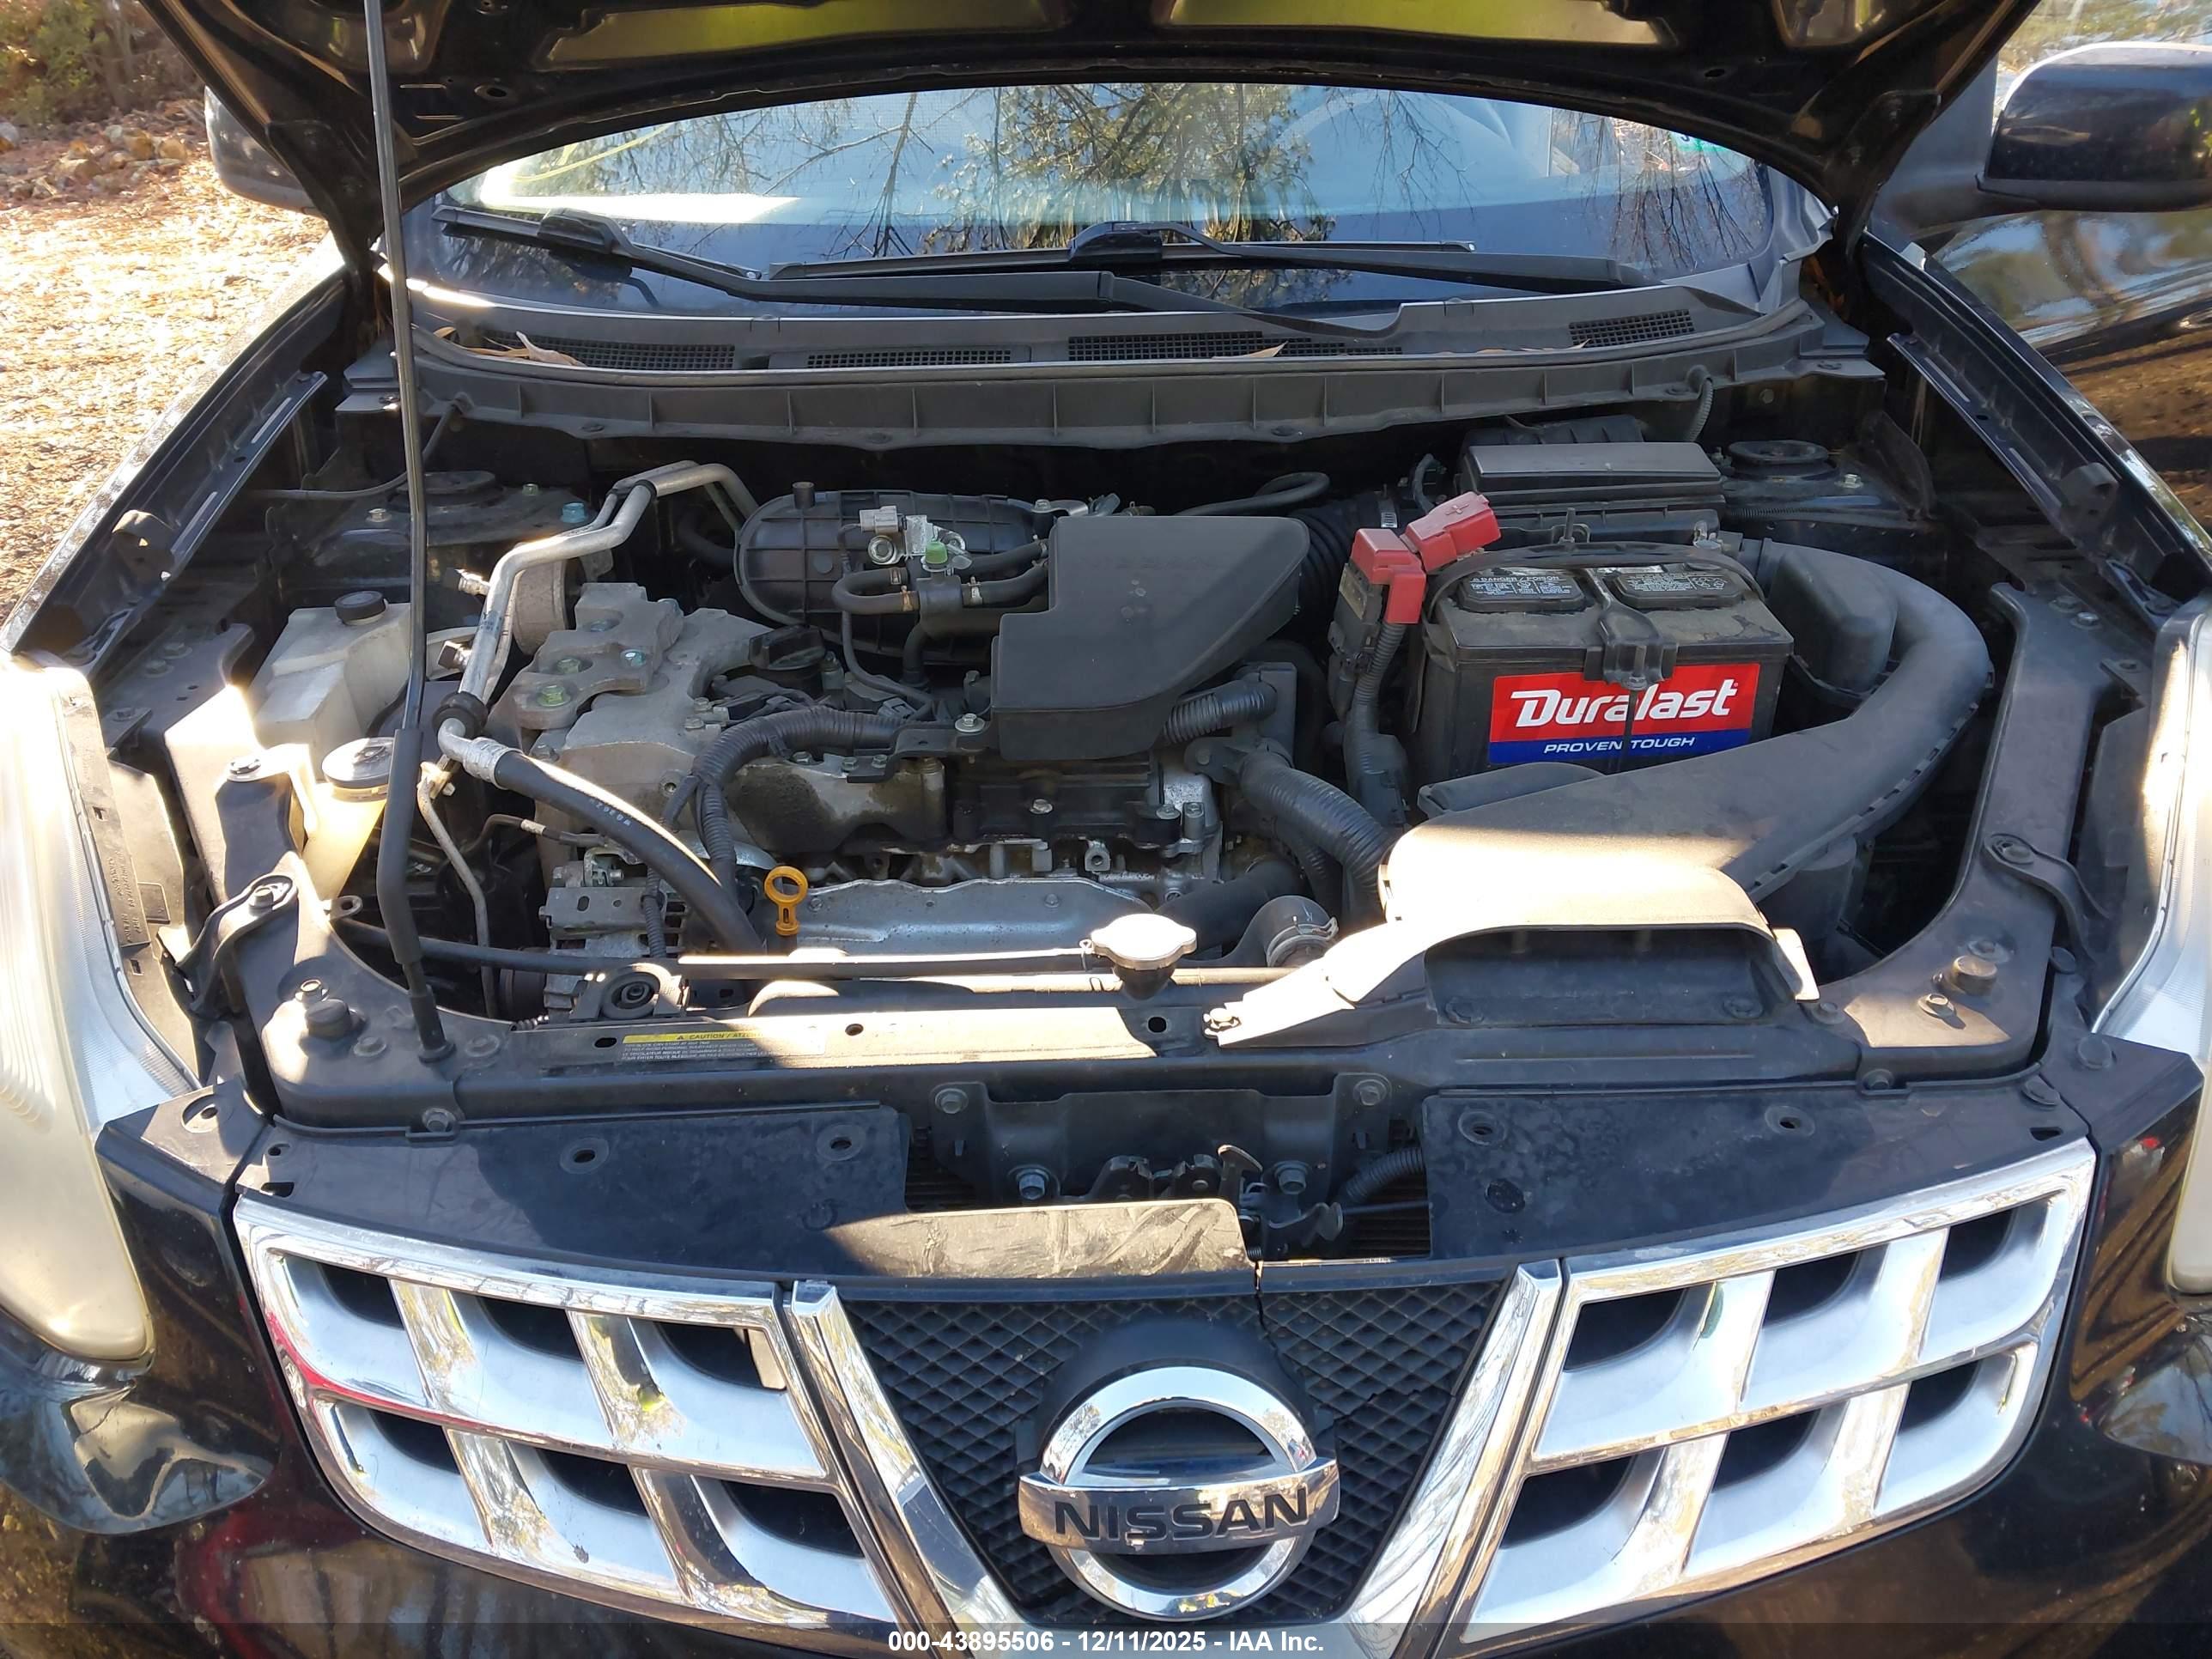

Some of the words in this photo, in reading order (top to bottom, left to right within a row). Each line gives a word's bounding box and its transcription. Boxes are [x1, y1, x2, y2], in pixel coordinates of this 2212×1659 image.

[1510, 678, 1738, 727] Duralast
[1544, 739, 1623, 754] PROVEN
[1630, 737, 1695, 750] TOUGH
[1054, 1489, 1310, 1540] NISSAN
